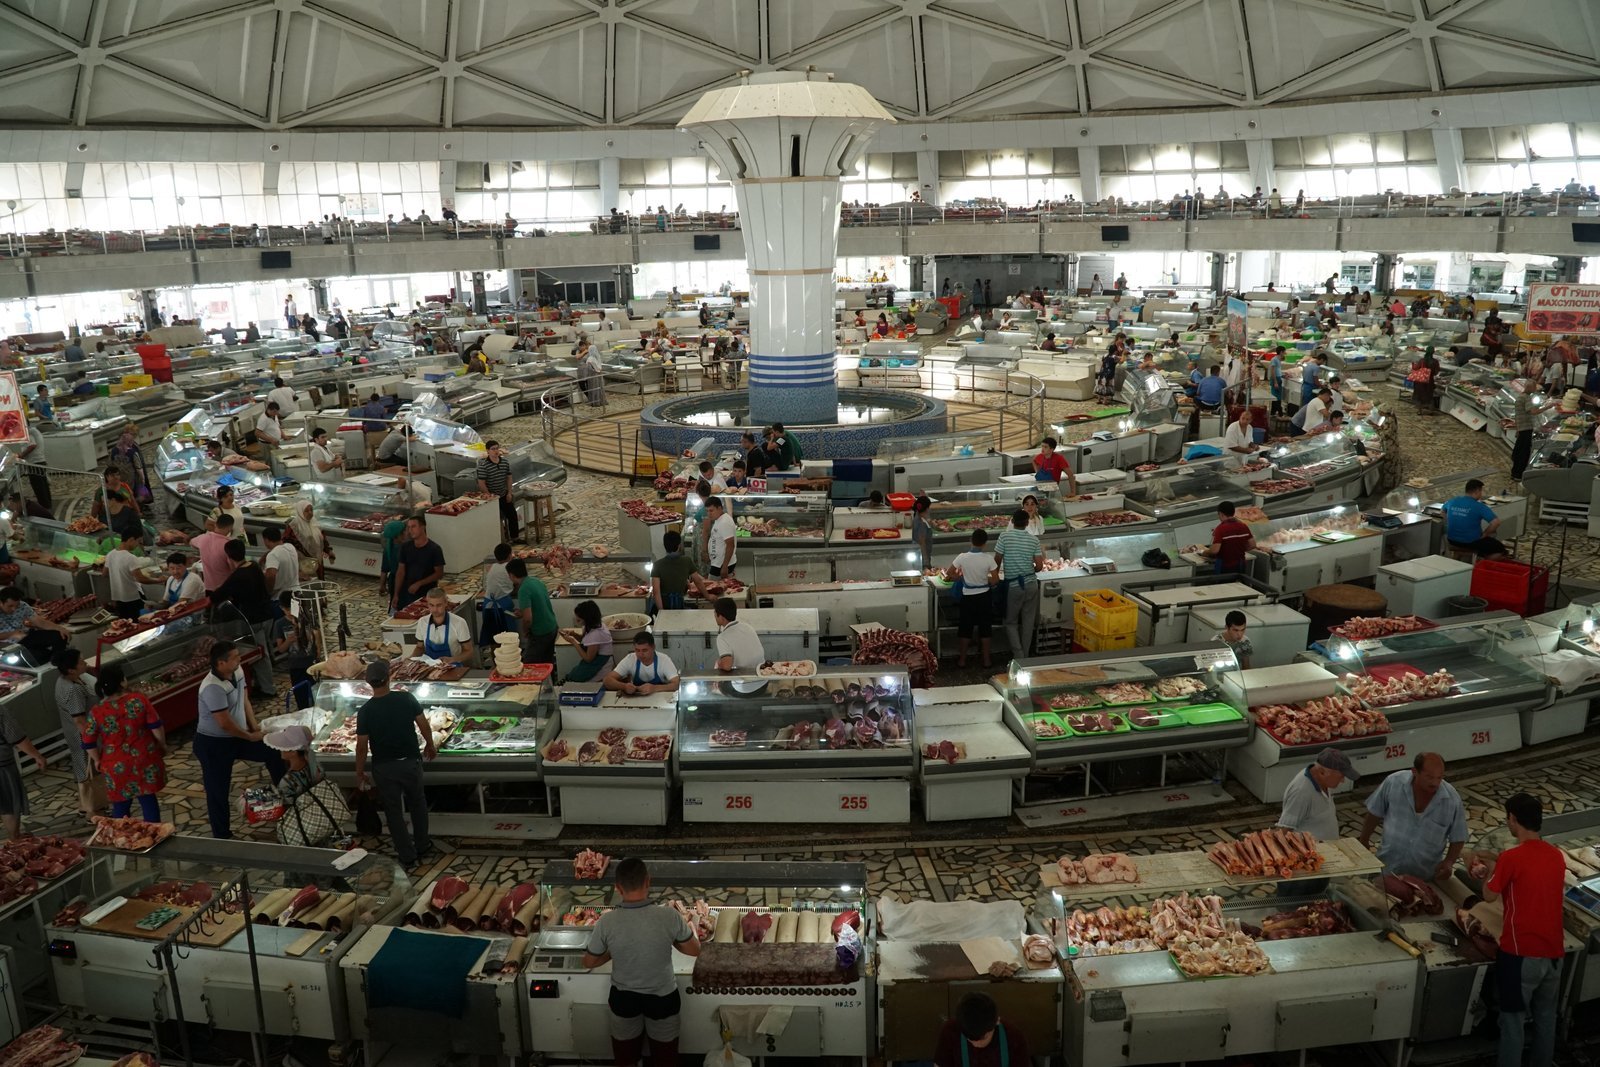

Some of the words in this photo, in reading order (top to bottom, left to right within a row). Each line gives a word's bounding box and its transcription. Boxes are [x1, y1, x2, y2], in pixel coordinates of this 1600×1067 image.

[364, 558, 377, 567] 107
[788, 570, 807, 579] 275
[1472, 731, 1491, 744] 251
[1385, 744, 1406, 759] 252
[726, 796, 752, 810] 256
[841, 796, 868, 810] 255
[1163, 793, 1190, 803] 253
[1060, 807, 1087, 817] 254
[494, 822, 522, 832] 257
